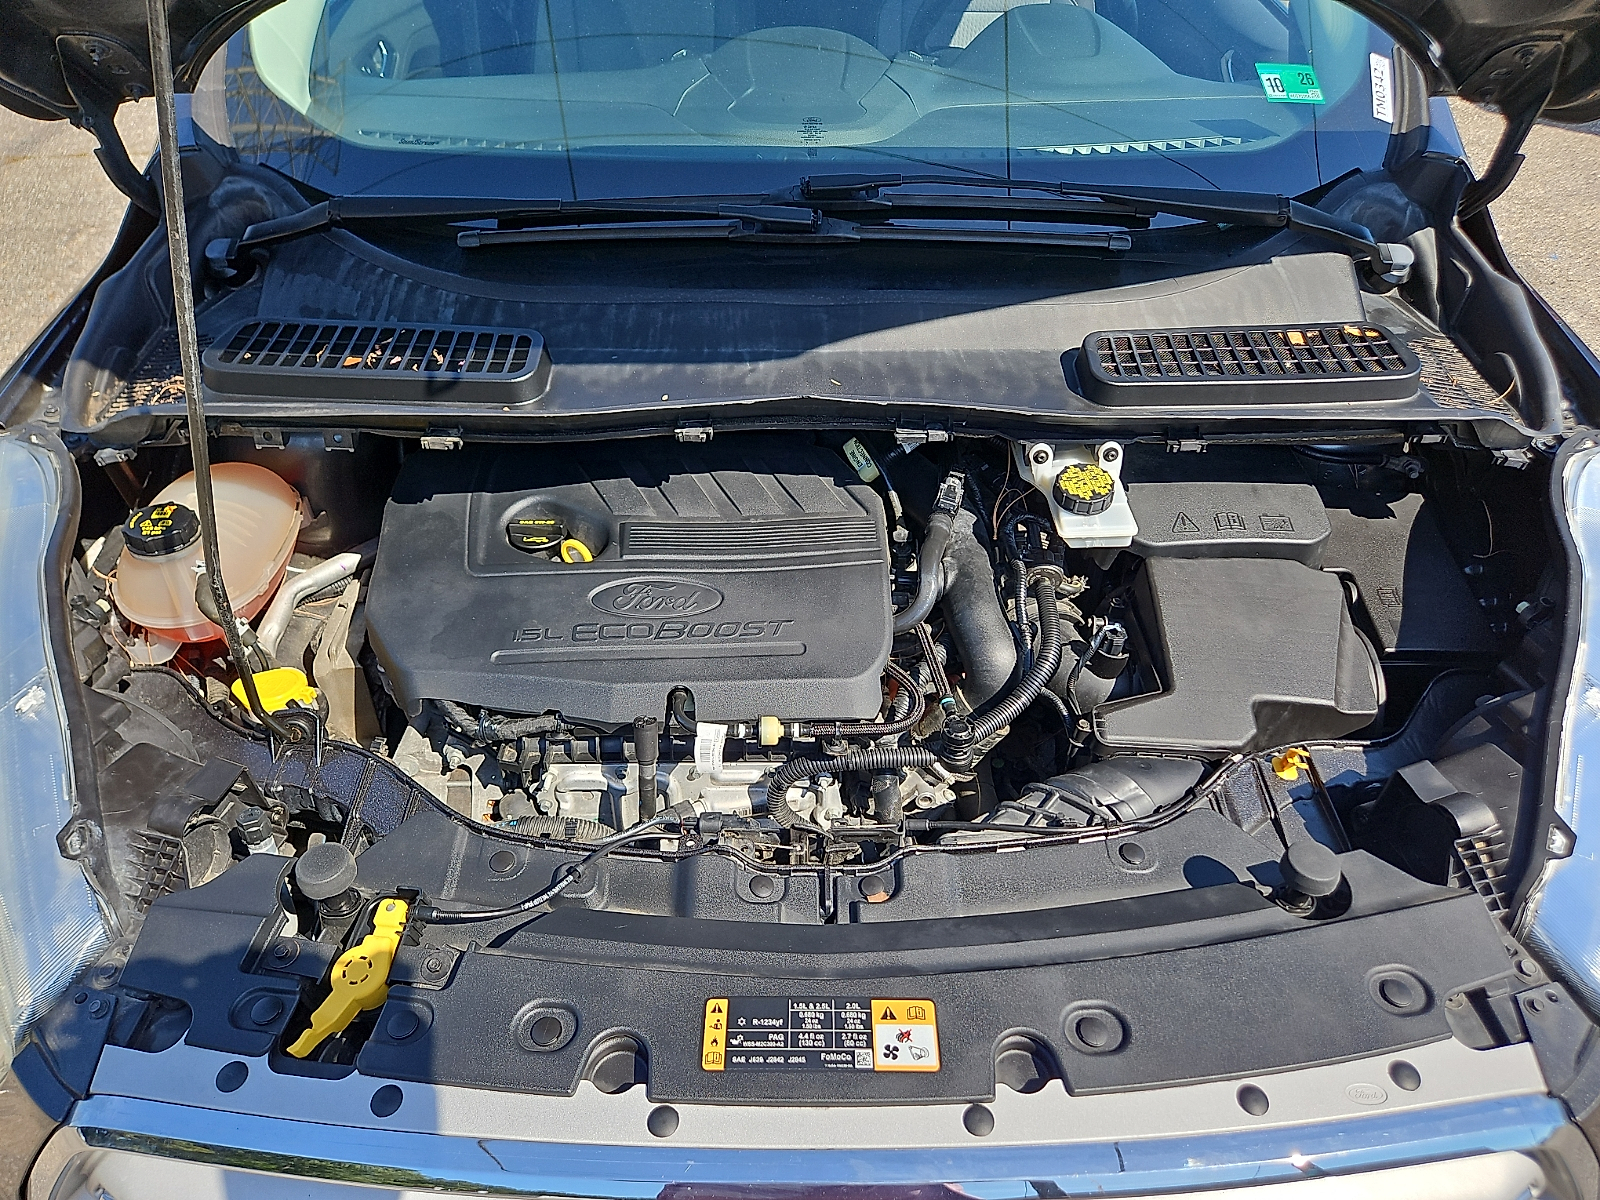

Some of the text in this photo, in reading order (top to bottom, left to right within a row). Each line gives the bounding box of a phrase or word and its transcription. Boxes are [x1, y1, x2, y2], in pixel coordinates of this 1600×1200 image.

[1297, 72, 1315, 86] 26
[1265, 77, 1285, 93] 10
[612, 581, 701, 612] Ford
[511, 627, 565, 643] 1.5L
[845, 1002, 861, 1010] 2.0L
[816, 1011, 825, 1020] kg
[858, 1012, 867, 1020] kg
[752, 1018, 784, 1028] R-1234yf
[768, 1033, 785, 1041] PAG
[798, 1032, 809, 1040] 4.4
[841, 1032, 852, 1040] 2.7
[731, 1055, 747, 1064] SAE
[820, 1052, 852, 1061] FoMoCo
